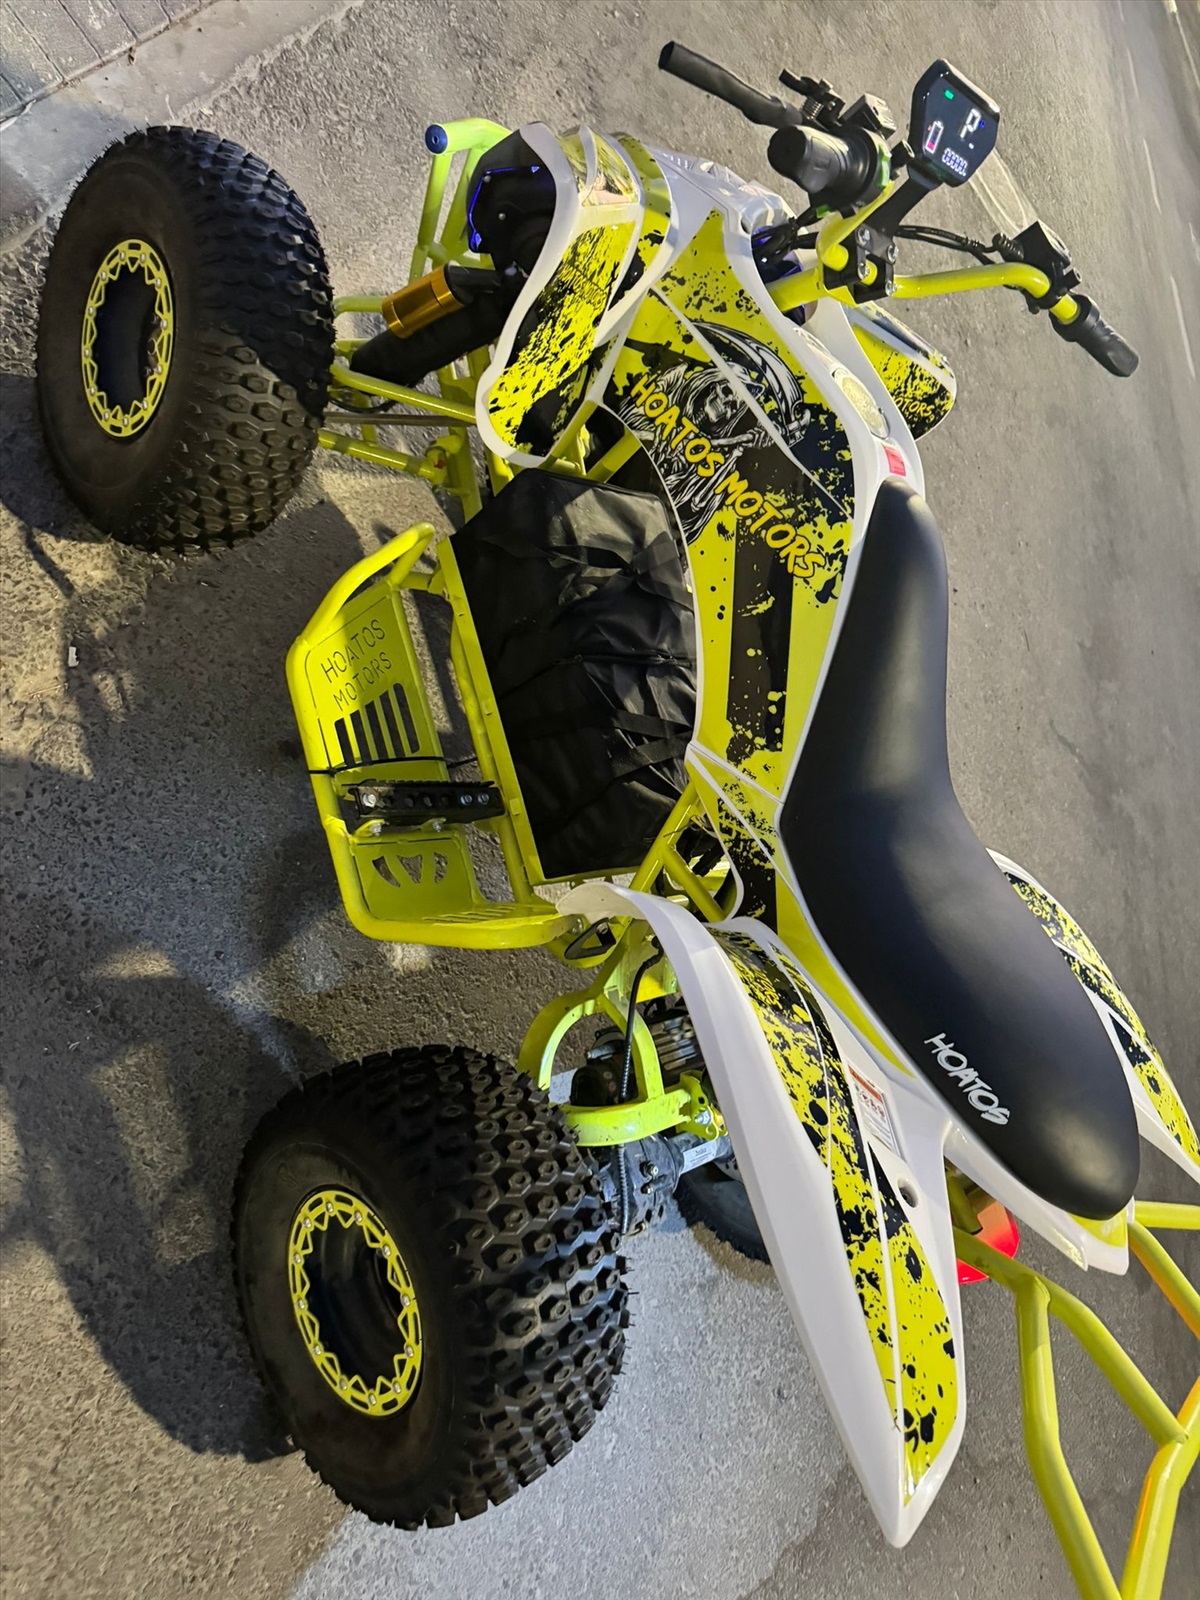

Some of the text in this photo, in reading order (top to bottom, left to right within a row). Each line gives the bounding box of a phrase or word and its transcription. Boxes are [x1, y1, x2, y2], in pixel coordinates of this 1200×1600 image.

[959, 108, 981, 139] P
[893, 396, 935, 417] OTORS
[630, 375, 826, 578] HOATOS MOTORS
[320, 619, 385, 683] HOATOS
[333, 651, 392, 711] MOTORS
[924, 1032, 1010, 1125] HOATOS
